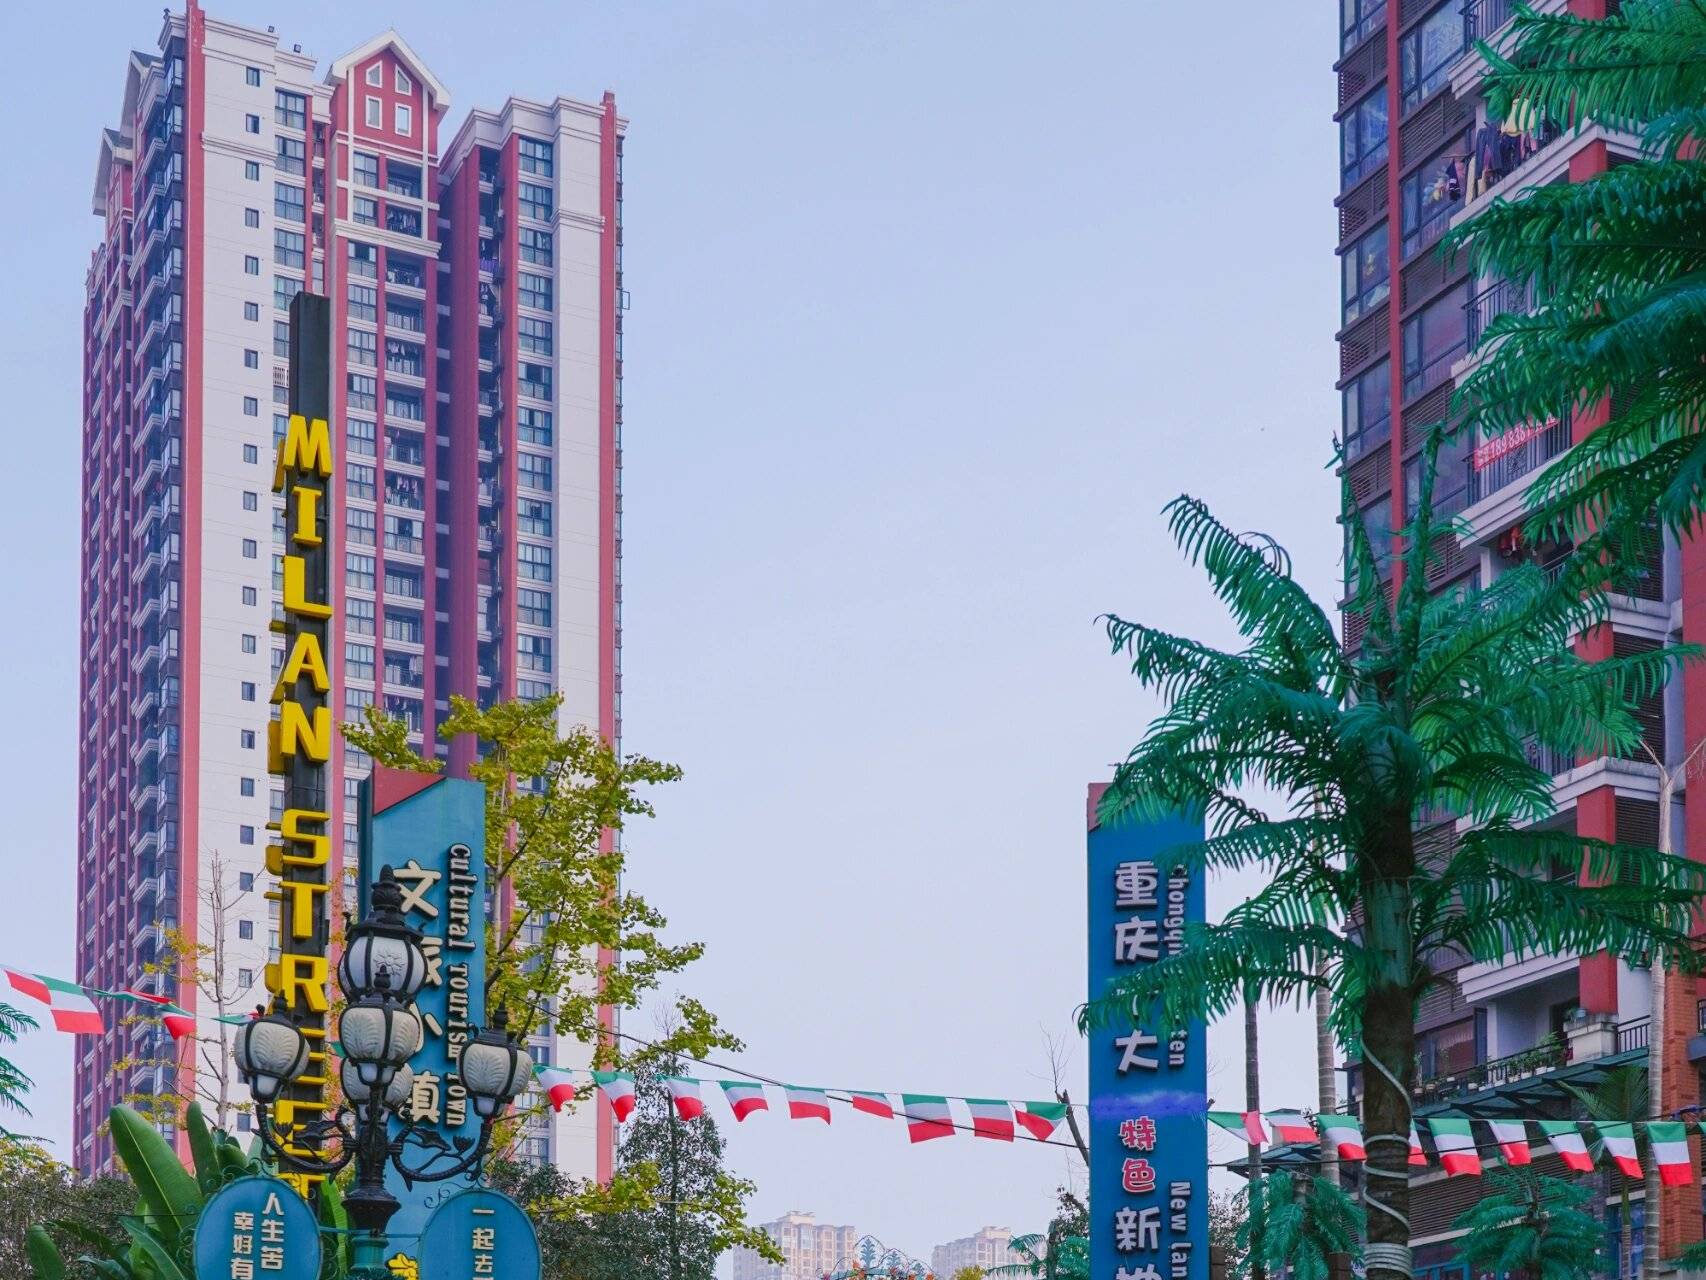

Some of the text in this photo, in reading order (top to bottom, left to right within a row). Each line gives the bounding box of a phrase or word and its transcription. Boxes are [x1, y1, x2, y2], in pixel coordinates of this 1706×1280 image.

[282, 414, 333, 763] MILAN
[1115, 860, 1160, 1072] 重庆大
[261, 1192, 285, 1270] 人生苦
[1169, 1180, 1191, 1231] New
